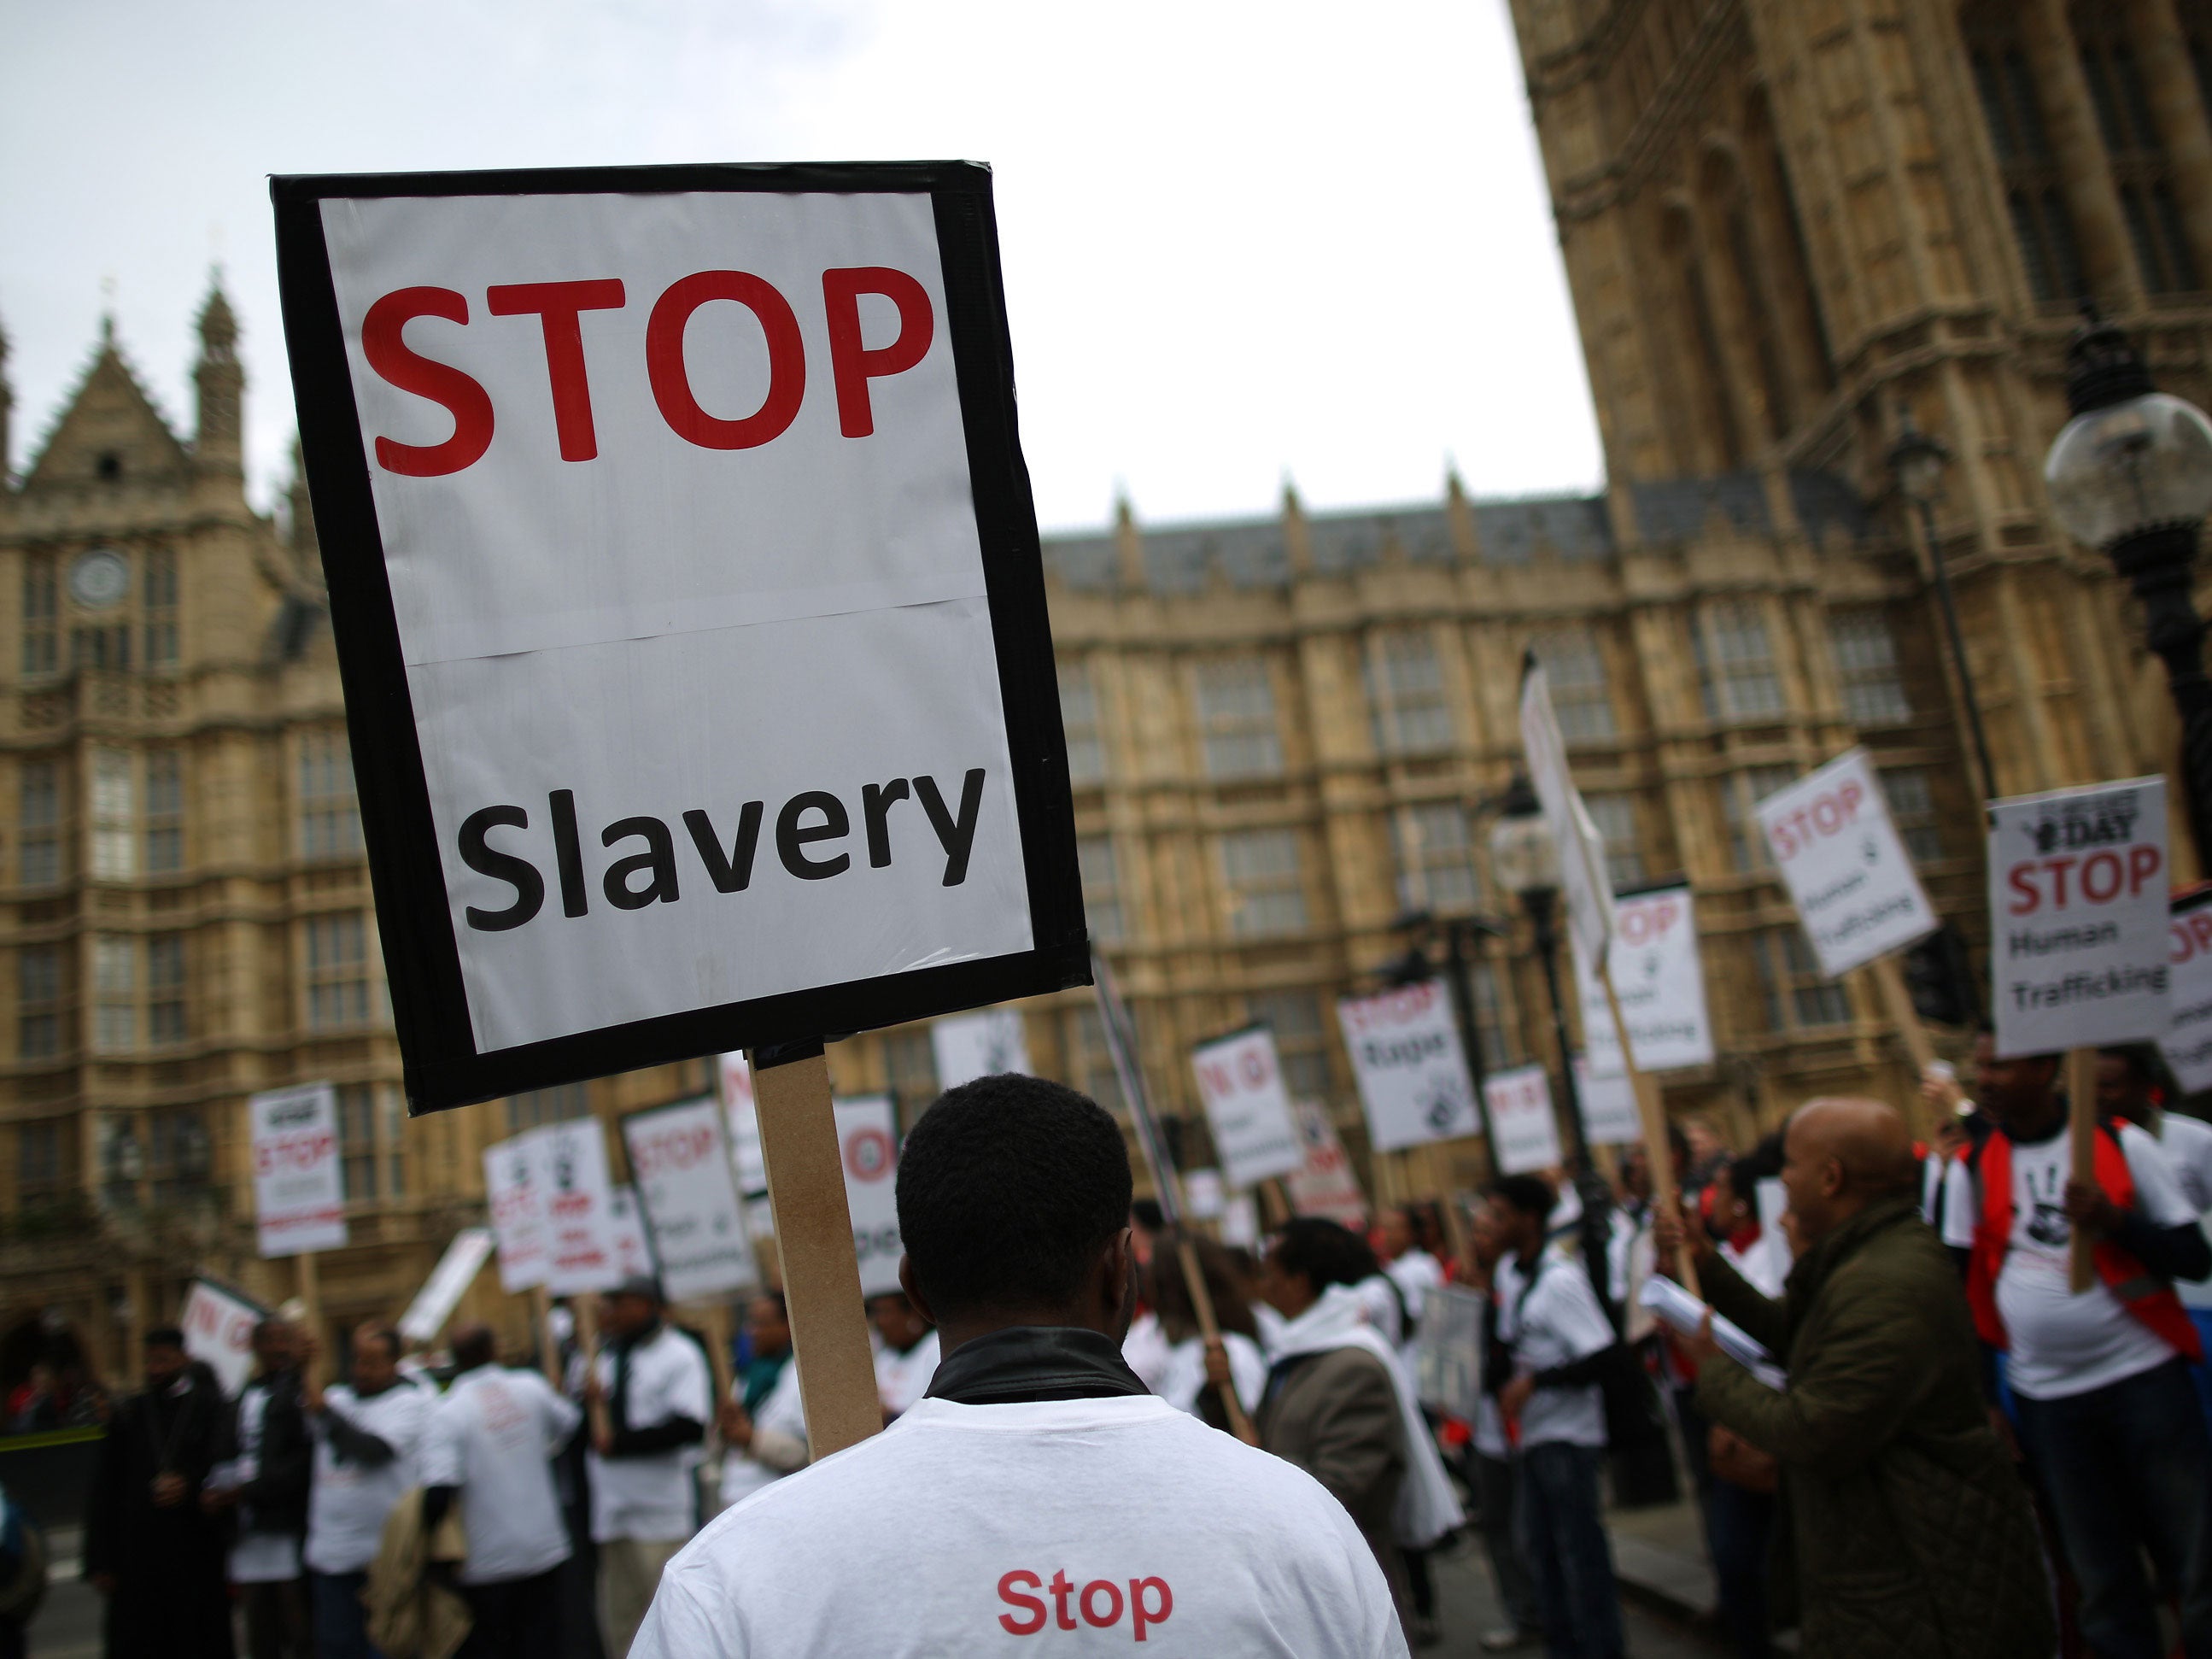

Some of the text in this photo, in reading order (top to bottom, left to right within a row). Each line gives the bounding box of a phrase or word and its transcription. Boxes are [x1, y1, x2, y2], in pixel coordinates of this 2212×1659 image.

[361, 267, 934, 478] STOP
[457, 768, 986, 932] Slavery
[1771, 779, 1862, 863] STOP
[2008, 842, 2162, 916] STOP
[1618, 901, 1679, 947] OP
[2009, 922, 2118, 959] Human
[2169, 912, 2212, 964] OP
[2012, 964, 2169, 1011] Trafficking
[997, 1568, 1173, 1643] Stop
